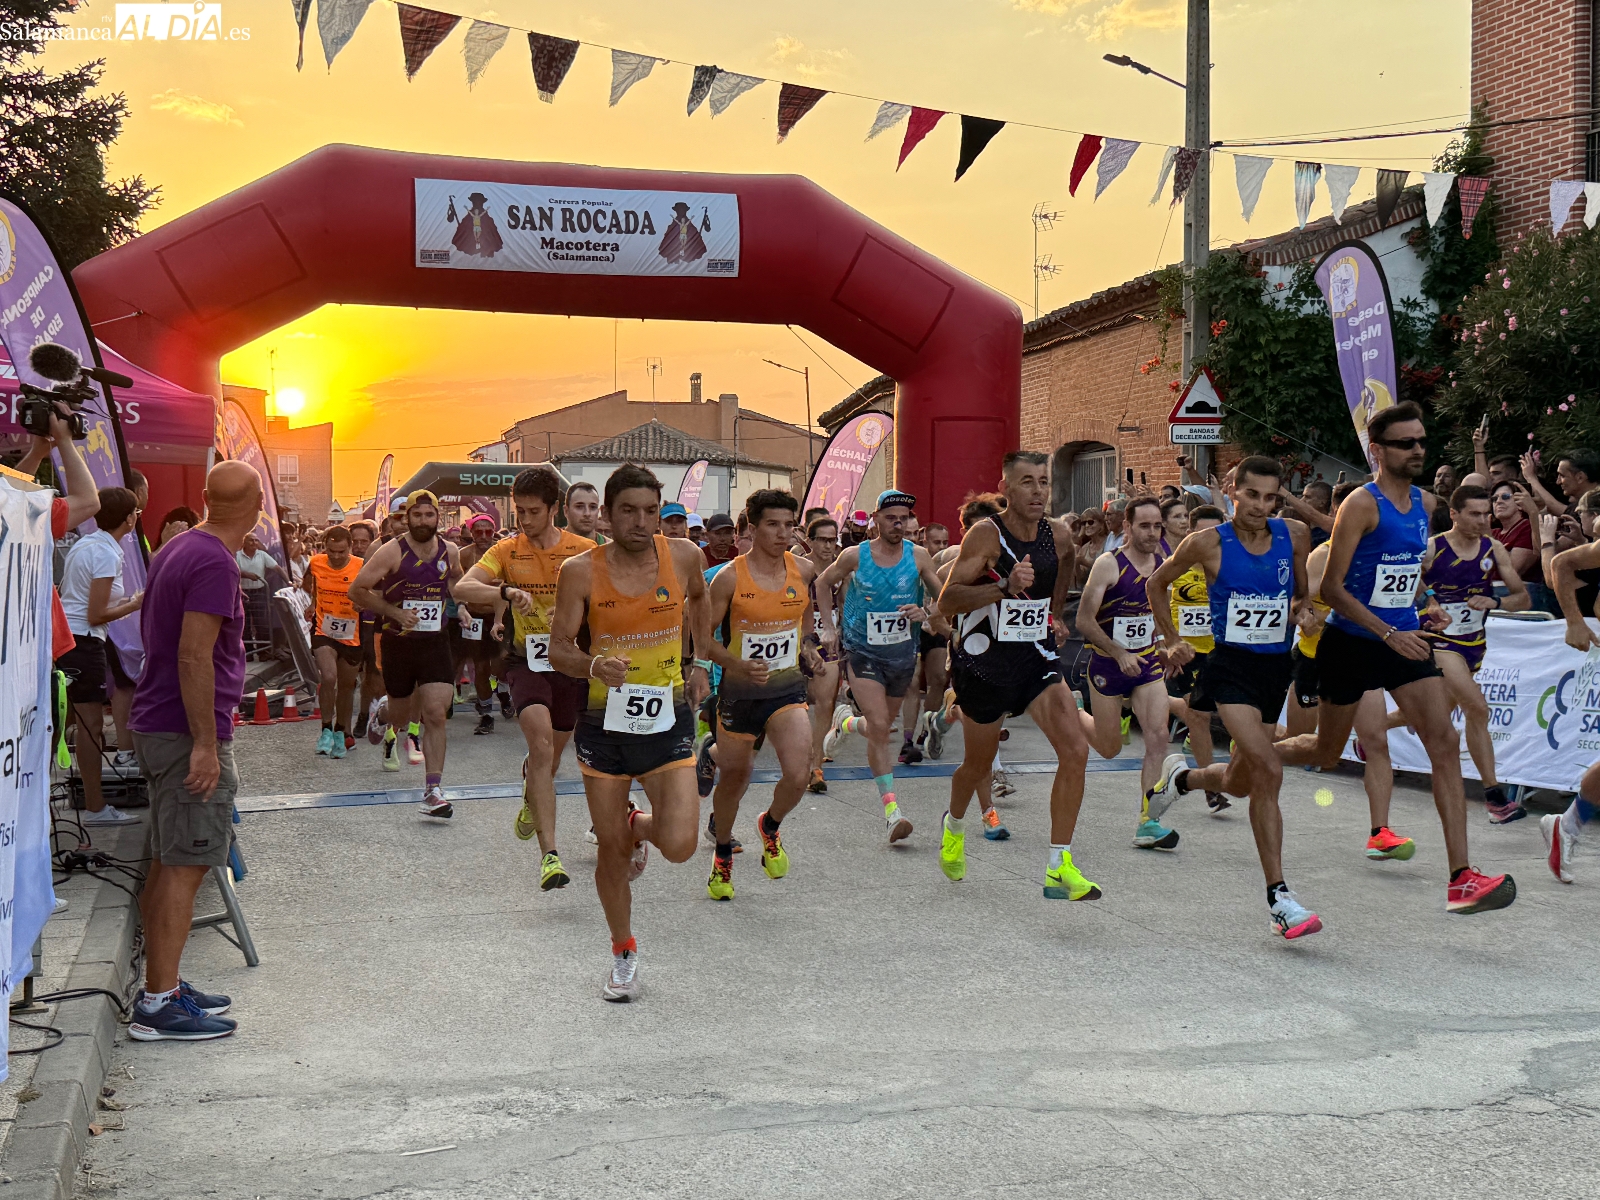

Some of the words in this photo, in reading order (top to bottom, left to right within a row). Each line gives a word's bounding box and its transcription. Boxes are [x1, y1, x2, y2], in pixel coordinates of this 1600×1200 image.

[548, 197, 580, 205] Carrera
[581, 199, 613, 207] Popular
[507, 204, 554, 231] SAN
[561, 207, 657, 235] ROCADA
[540, 236, 620, 253] Macotera
[547, 251, 616, 263] (Salamanca)
[1381, 573, 1418, 593] 287
[1005, 608, 1045, 627] 265
[1235, 609, 1282, 628] 272
[1460, 609, 1471, 623] 2
[330, 621, 347, 632] 51
[873, 617, 907, 633] 179
[1125, 623, 1147, 638] 56
[749, 639, 790, 659] 201
[625, 696, 664, 718] 50
